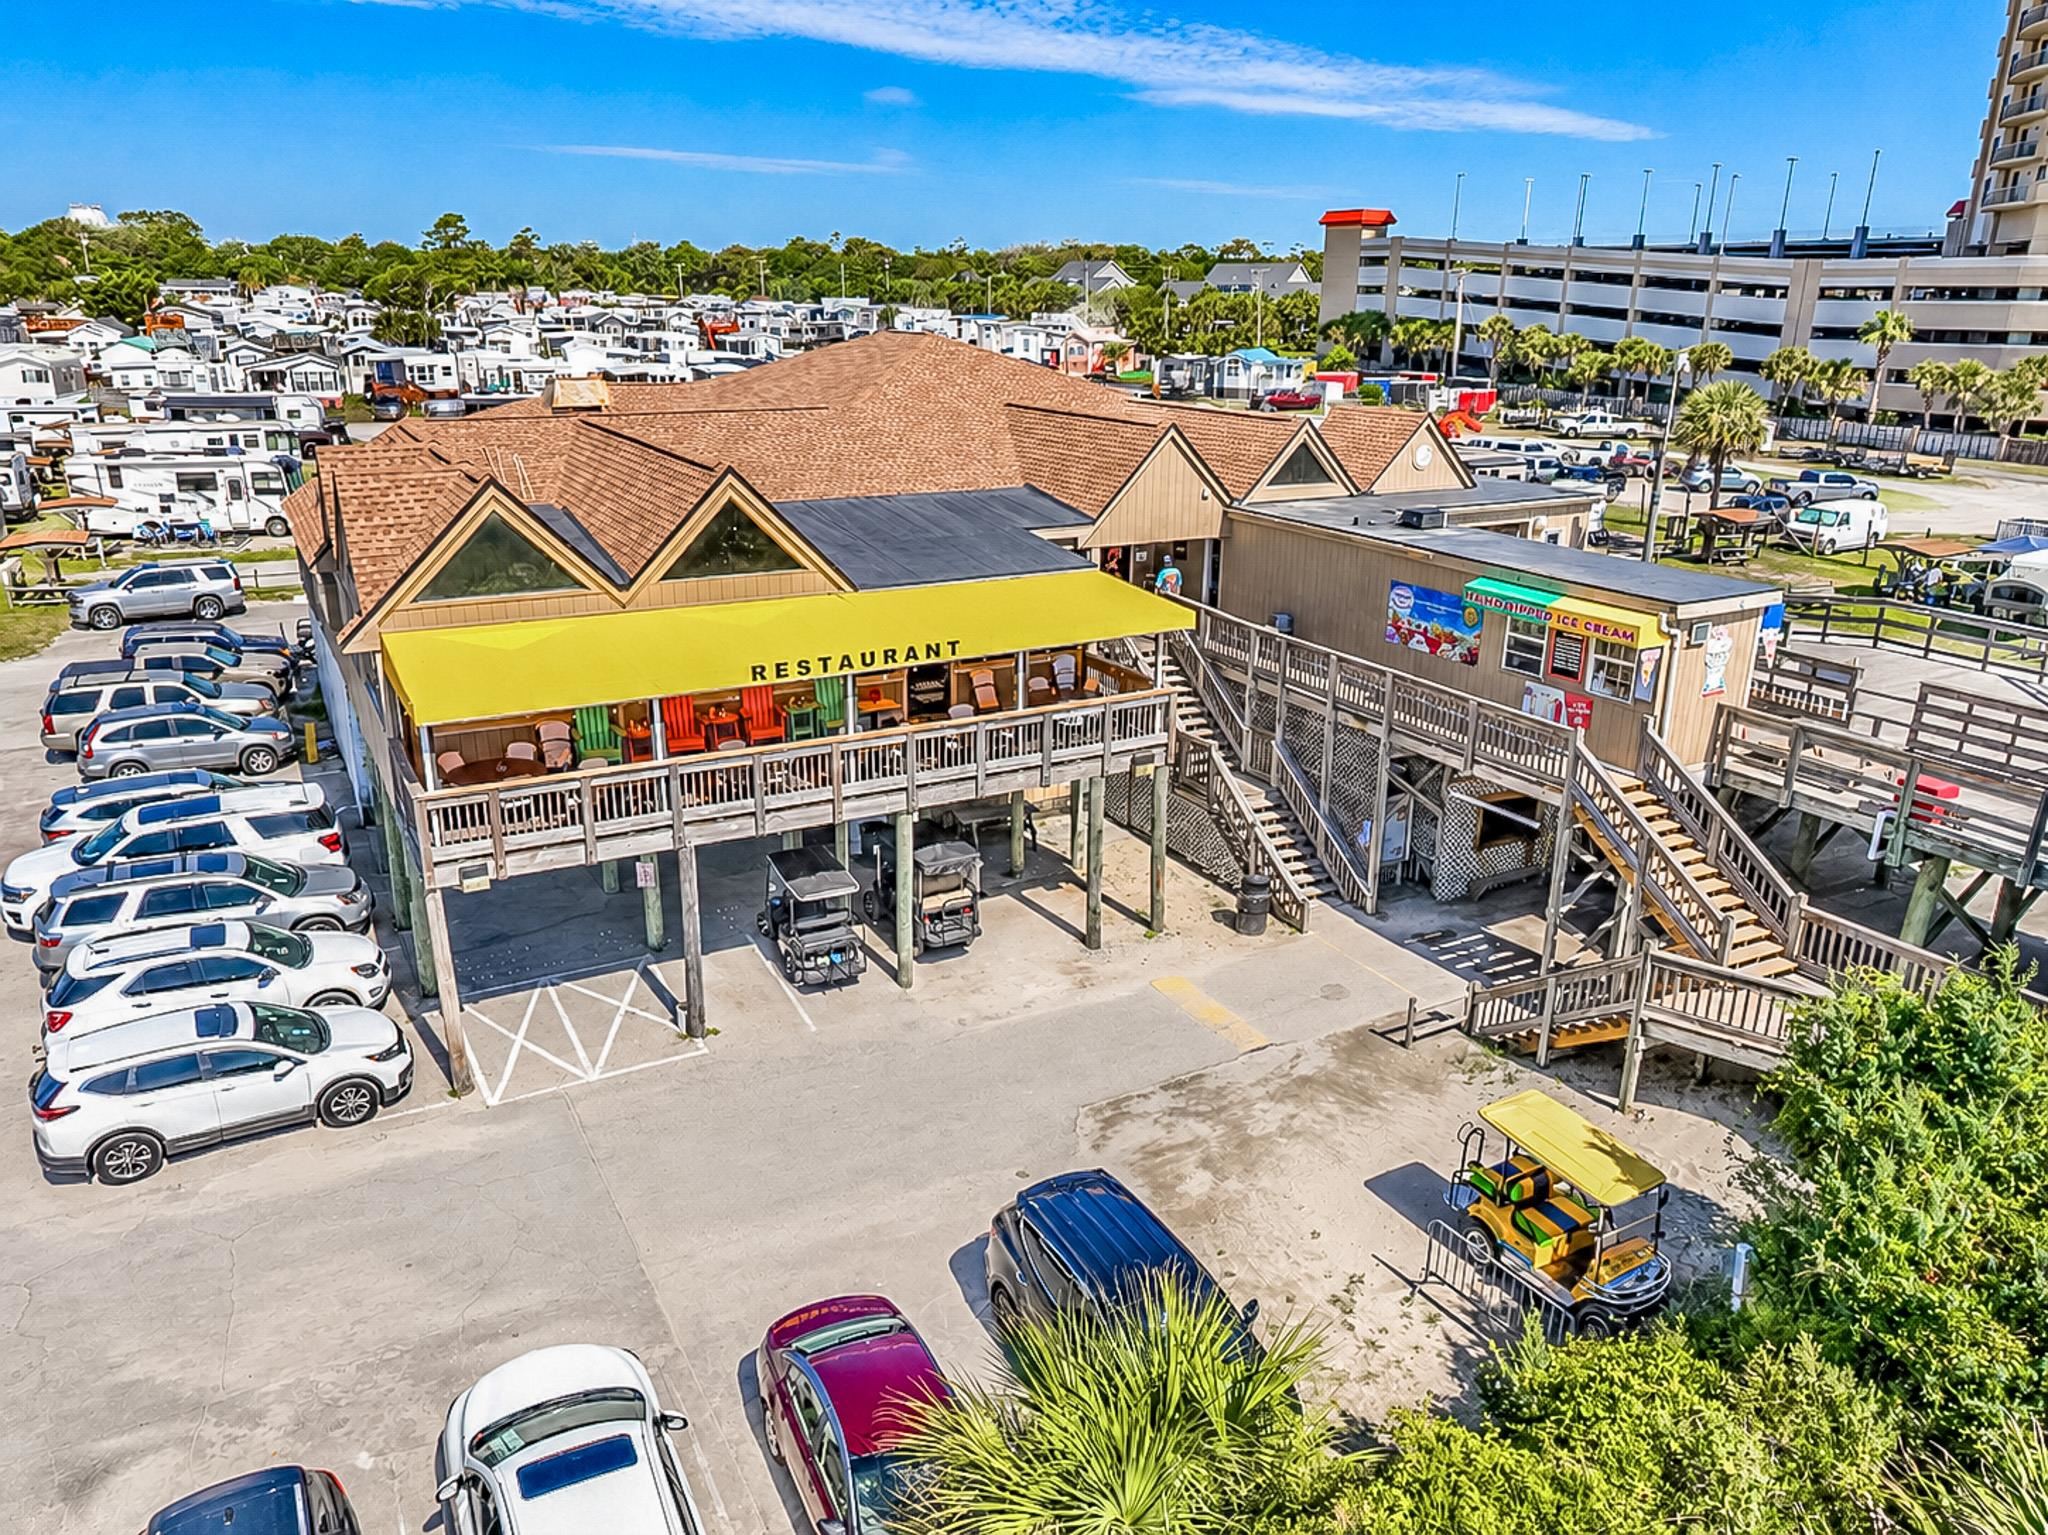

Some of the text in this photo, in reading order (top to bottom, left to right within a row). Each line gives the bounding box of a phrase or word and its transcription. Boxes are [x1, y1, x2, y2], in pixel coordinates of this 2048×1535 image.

[1556, 613, 1578, 628] ICE
[1584, 621, 1635, 643] CREAM
[751, 640, 961, 681] RESTAURANT
